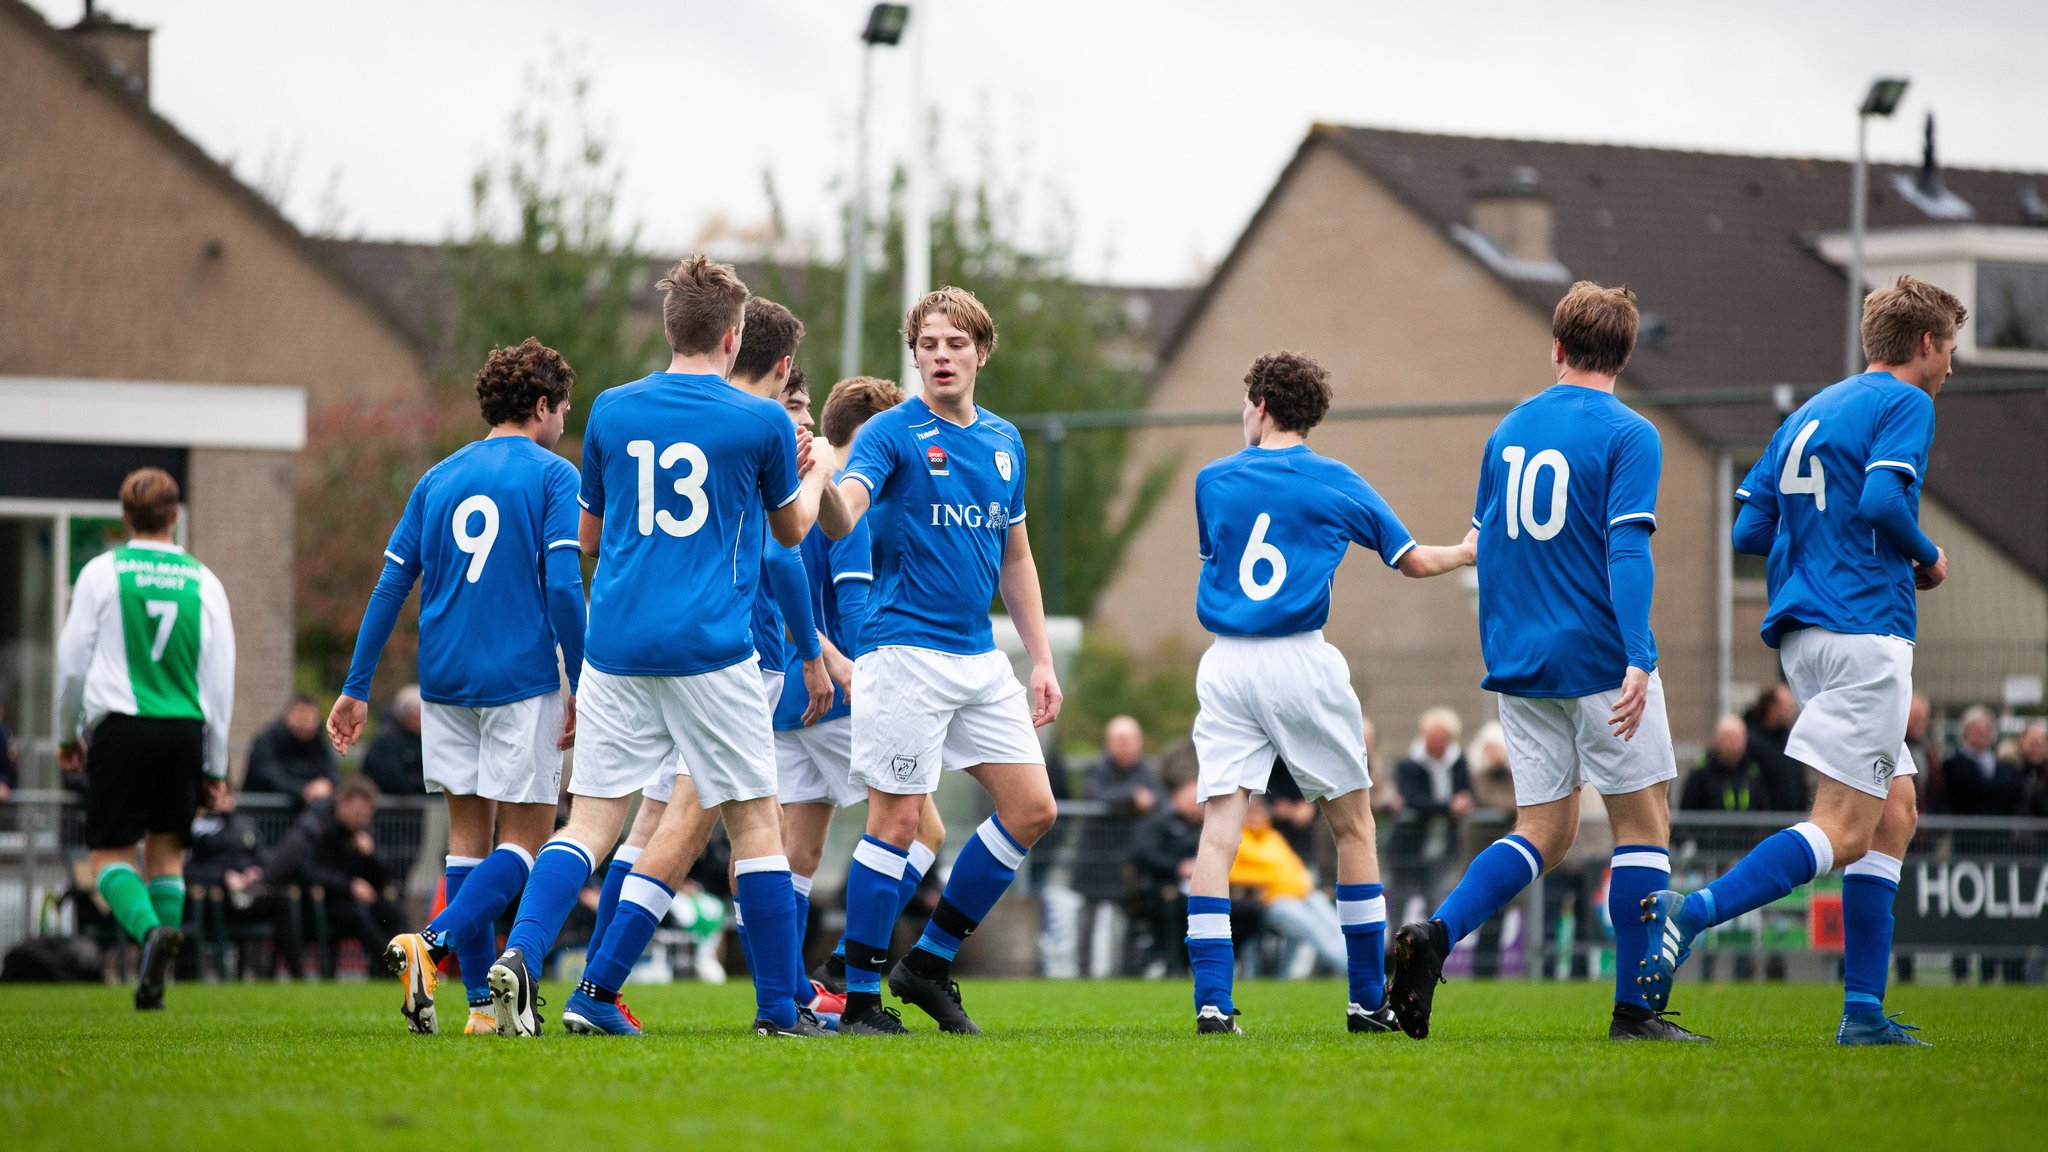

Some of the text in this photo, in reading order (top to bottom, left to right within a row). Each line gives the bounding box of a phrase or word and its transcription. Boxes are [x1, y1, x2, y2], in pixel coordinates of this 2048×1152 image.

[916, 427, 940, 440] hummel
[1780, 420, 1826, 511] 4
[626, 440, 709, 537] 13
[930, 503, 982, 528] ING
[1502, 446, 1569, 541] 10
[135, 573, 186, 590] SPORT
[452, 495, 499, 583] 9
[1238, 512, 1286, 601] 6
[146, 600, 178, 661] 7
